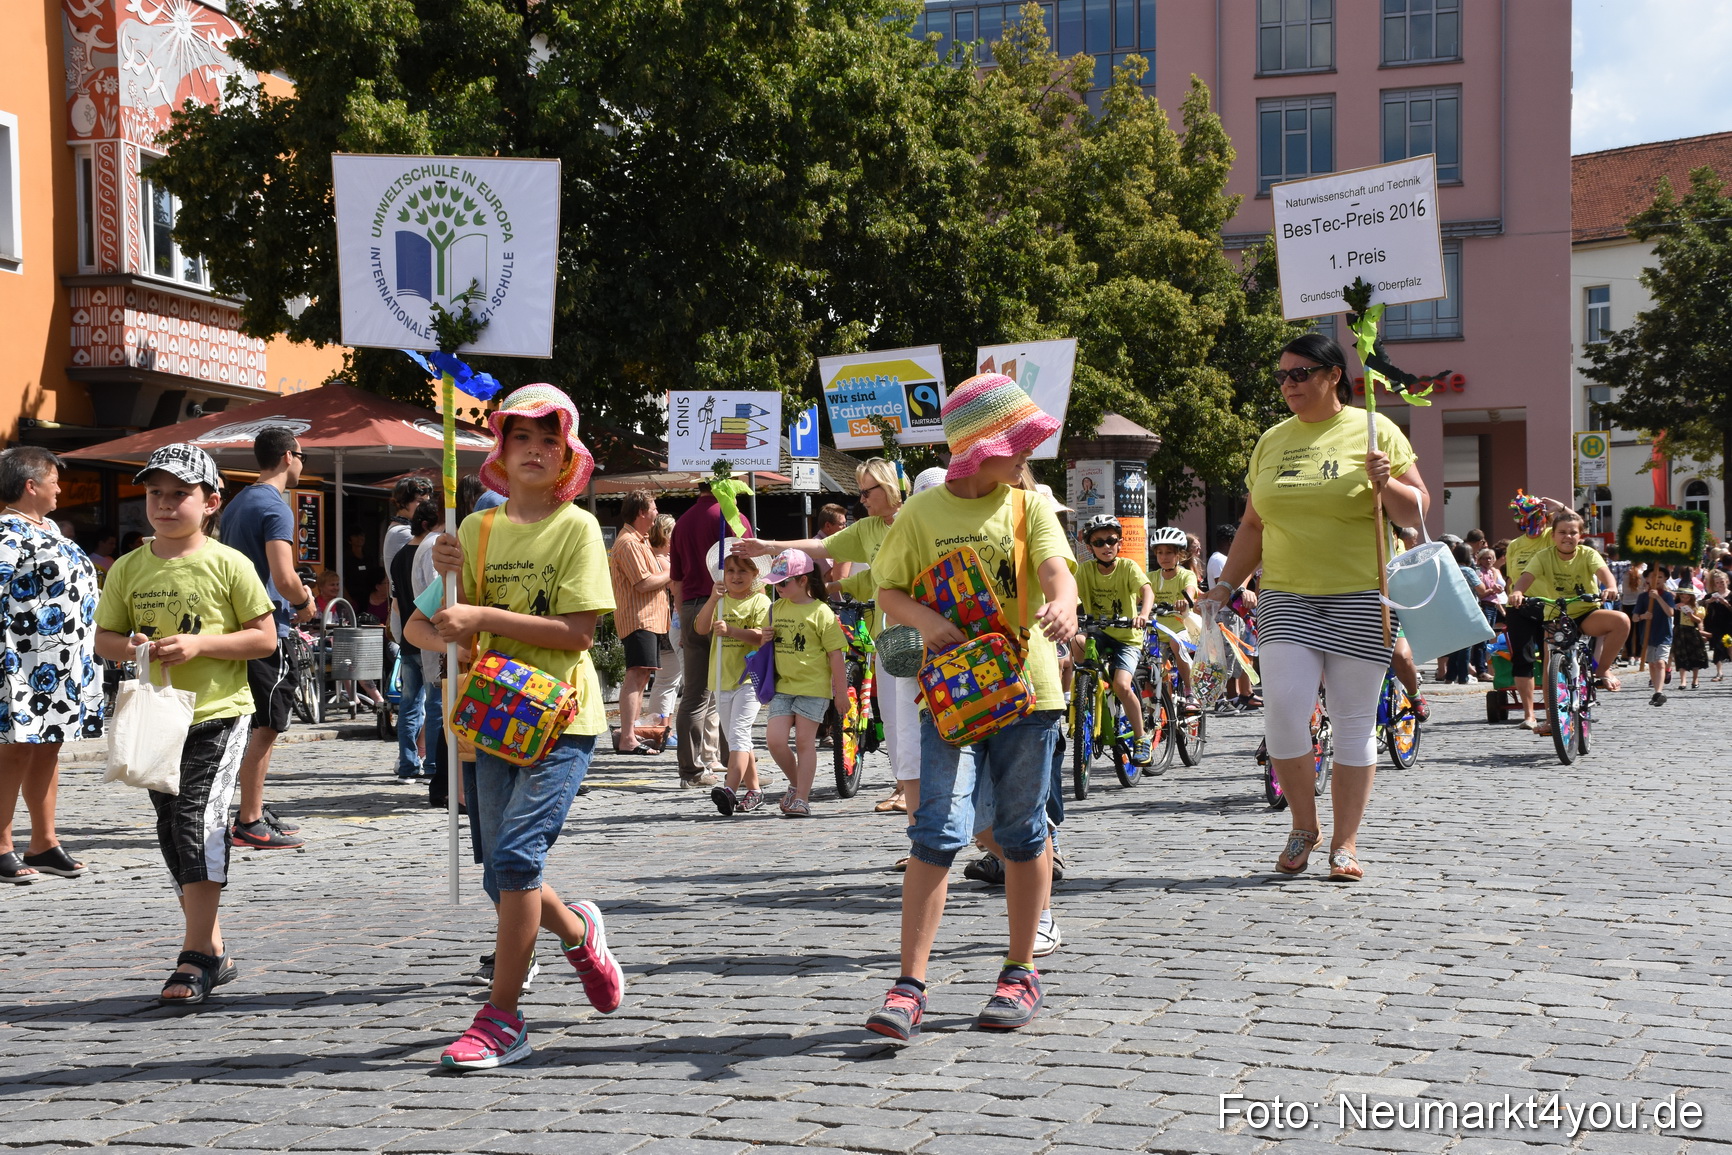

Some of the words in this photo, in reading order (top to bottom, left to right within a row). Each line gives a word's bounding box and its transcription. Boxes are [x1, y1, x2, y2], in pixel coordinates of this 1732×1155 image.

[1285, 186, 1366, 209] Naturwissenschaft
[1368, 183, 1385, 194] und
[1387, 175, 1421, 190] Technik
[371, 164, 460, 239] UMWELTSCHULE
[461, 170, 477, 188] IN
[476, 181, 514, 244] EUROPA
[1283, 208, 1385, 239] BesTec-Preis
[1389, 198, 1426, 221] 2016
[1329, 254, 1343, 270] 1.
[1347, 247, 1386, 267] Preis
[370, 246, 432, 340] INTERNATIONALE
[1300, 286, 1346, 303] Grundschu
[1378, 276, 1422, 292] Oberpfalz
[828, 393, 848, 404] Wir
[851, 391, 877, 402] sind
[676, 396, 690, 437] SINUS
[830, 401, 903, 420] Fairtrade
[1644, 518, 1682, 532] Schule
[935, 533, 989, 547] Grundschule
[1635, 534, 1687, 549] Wolfstein
[485, 560, 534, 572] Grundschule
